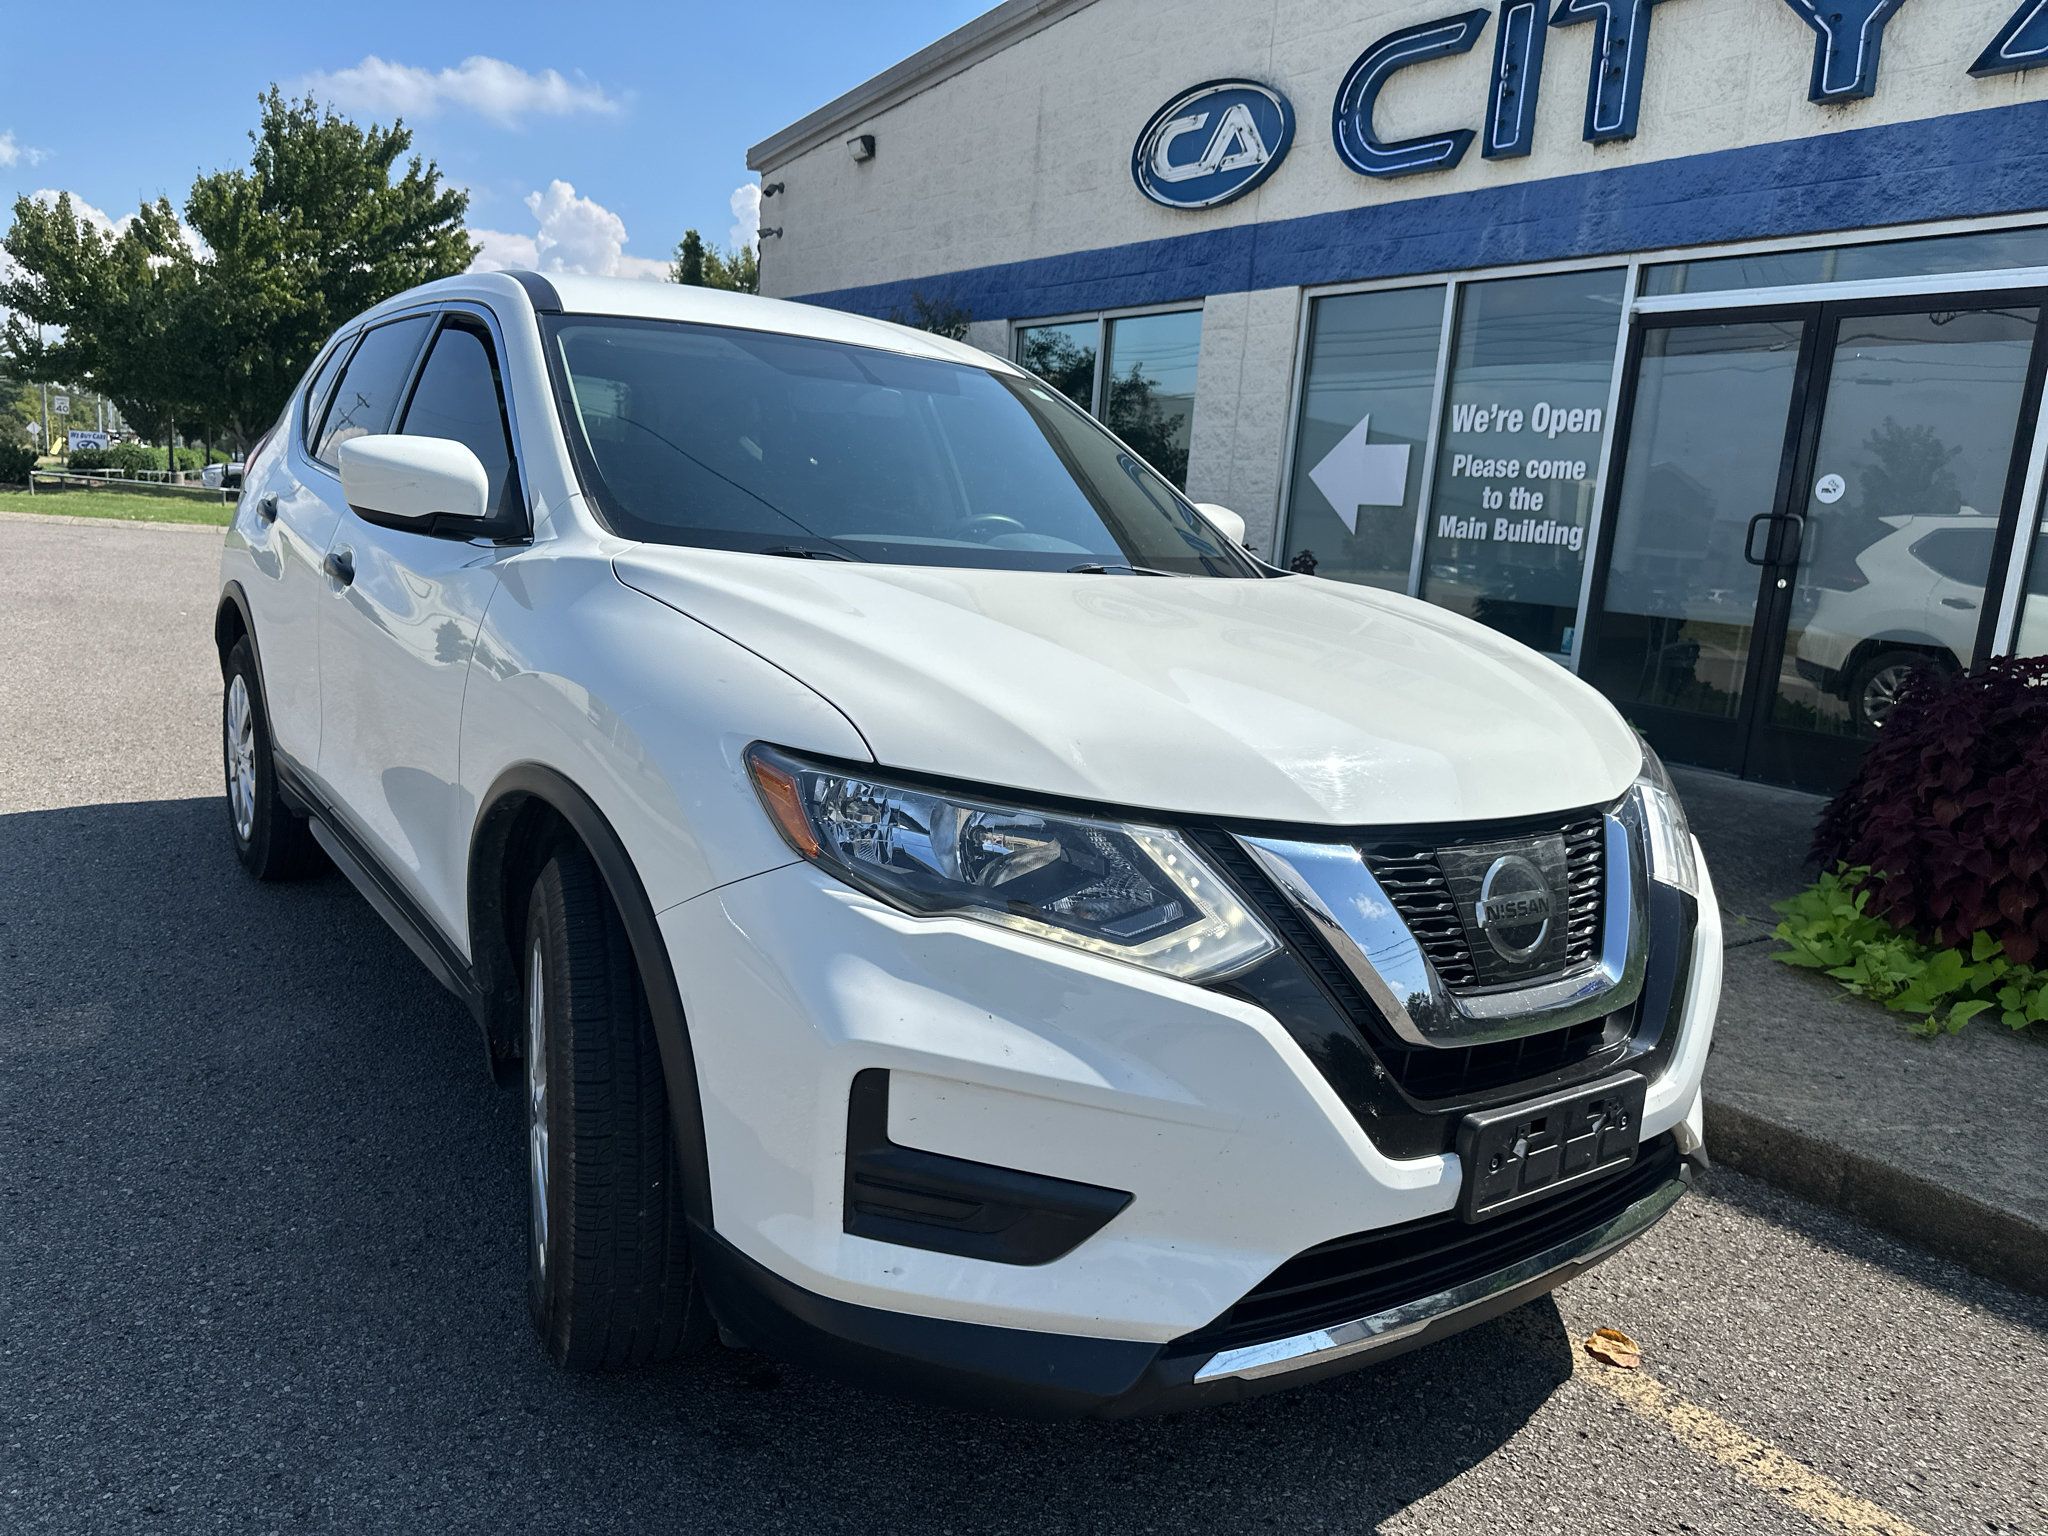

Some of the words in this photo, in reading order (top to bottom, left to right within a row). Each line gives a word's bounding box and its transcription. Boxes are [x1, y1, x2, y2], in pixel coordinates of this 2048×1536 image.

[1332, 0, 1905, 180] CITY
[1150, 103, 1270, 183] CA
[1452, 403, 1524, 433] We're
[1531, 402, 1602, 439] Open
[1452, 454, 1520, 478] Please
[1525, 459, 1587, 480] come
[1482, 486, 1503, 510] to
[1509, 487, 1544, 511] the
[1437, 515, 1488, 540] Main
[1493, 518, 1584, 552] Building
[1486, 898, 1549, 921] NISSAN
